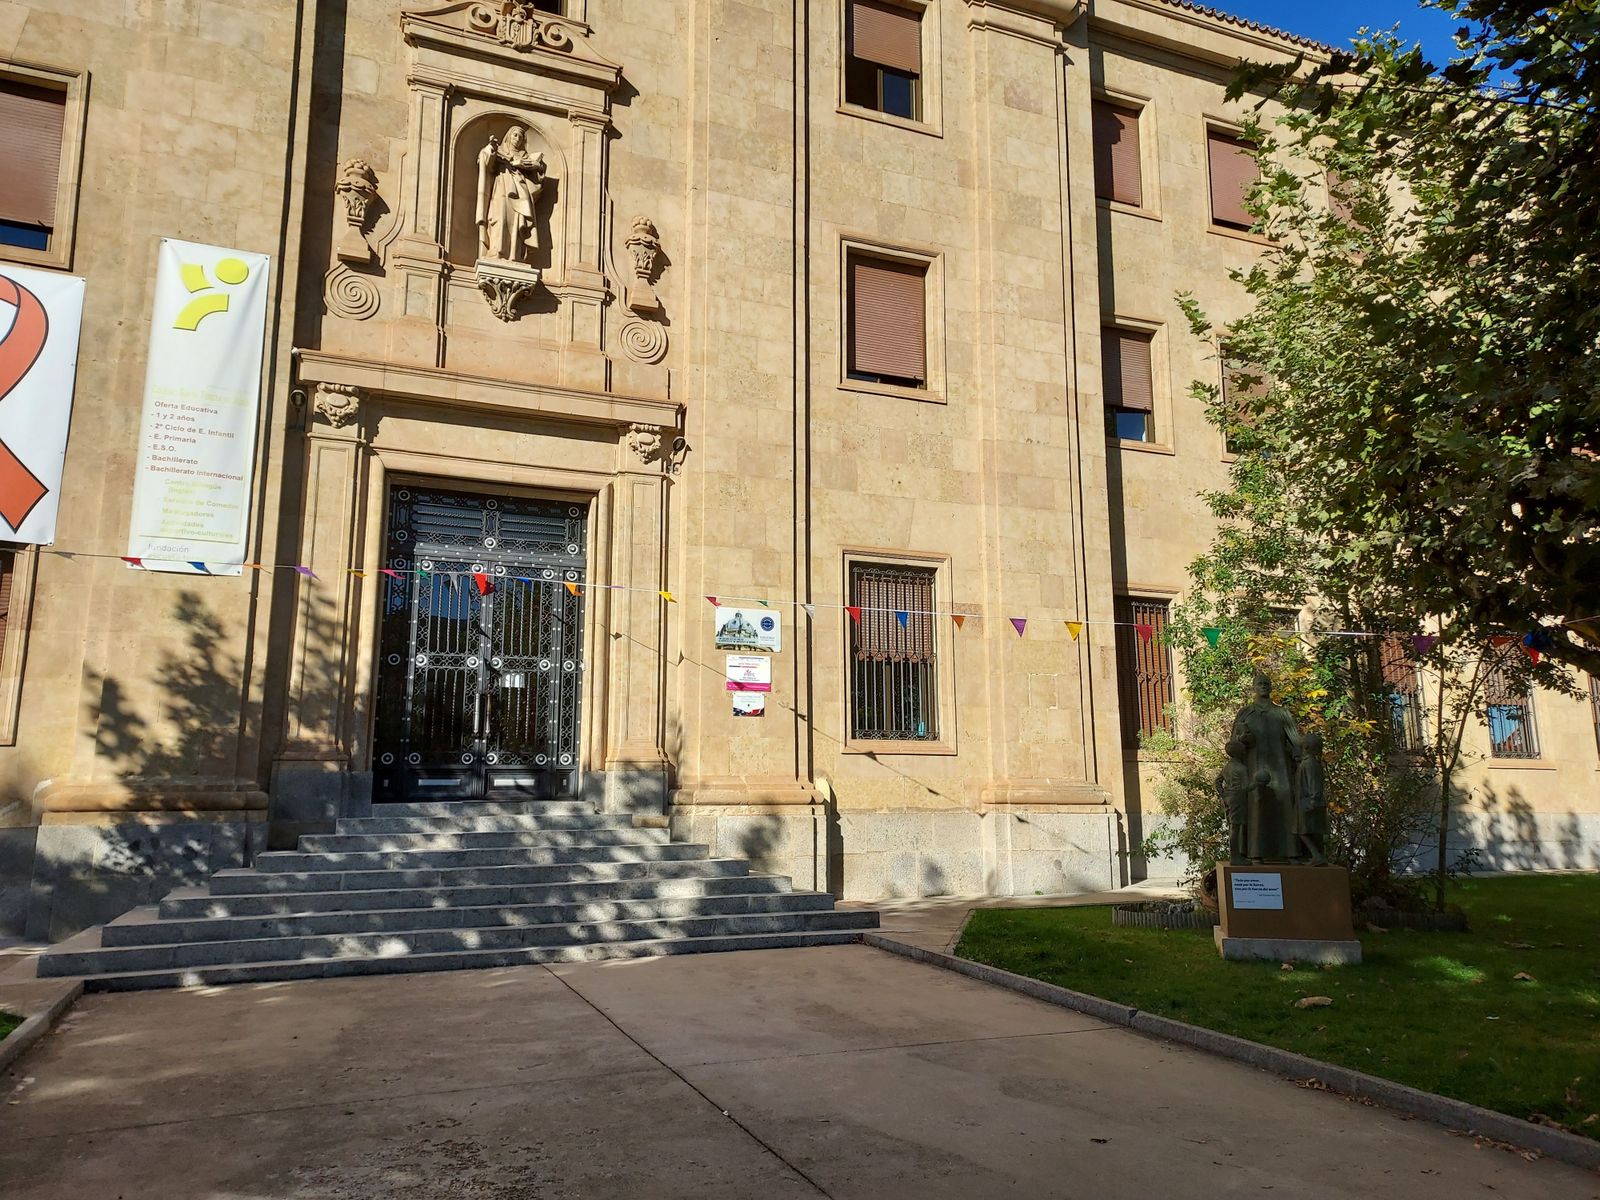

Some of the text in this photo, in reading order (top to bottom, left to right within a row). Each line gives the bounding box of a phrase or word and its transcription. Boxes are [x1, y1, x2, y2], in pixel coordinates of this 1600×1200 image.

[154, 401, 218, 414] Oferta Educativa
[176, 414, 195, 422] años
[165, 424, 185, 432] Ciclo
[208, 429, 235, 439] Infantil
[164, 434, 197, 444] Primaria
[152, 444, 177, 452] E.S.O.
[151, 454, 199, 465] Bachillerato
[150, 465, 195, 475] Bachillerato
